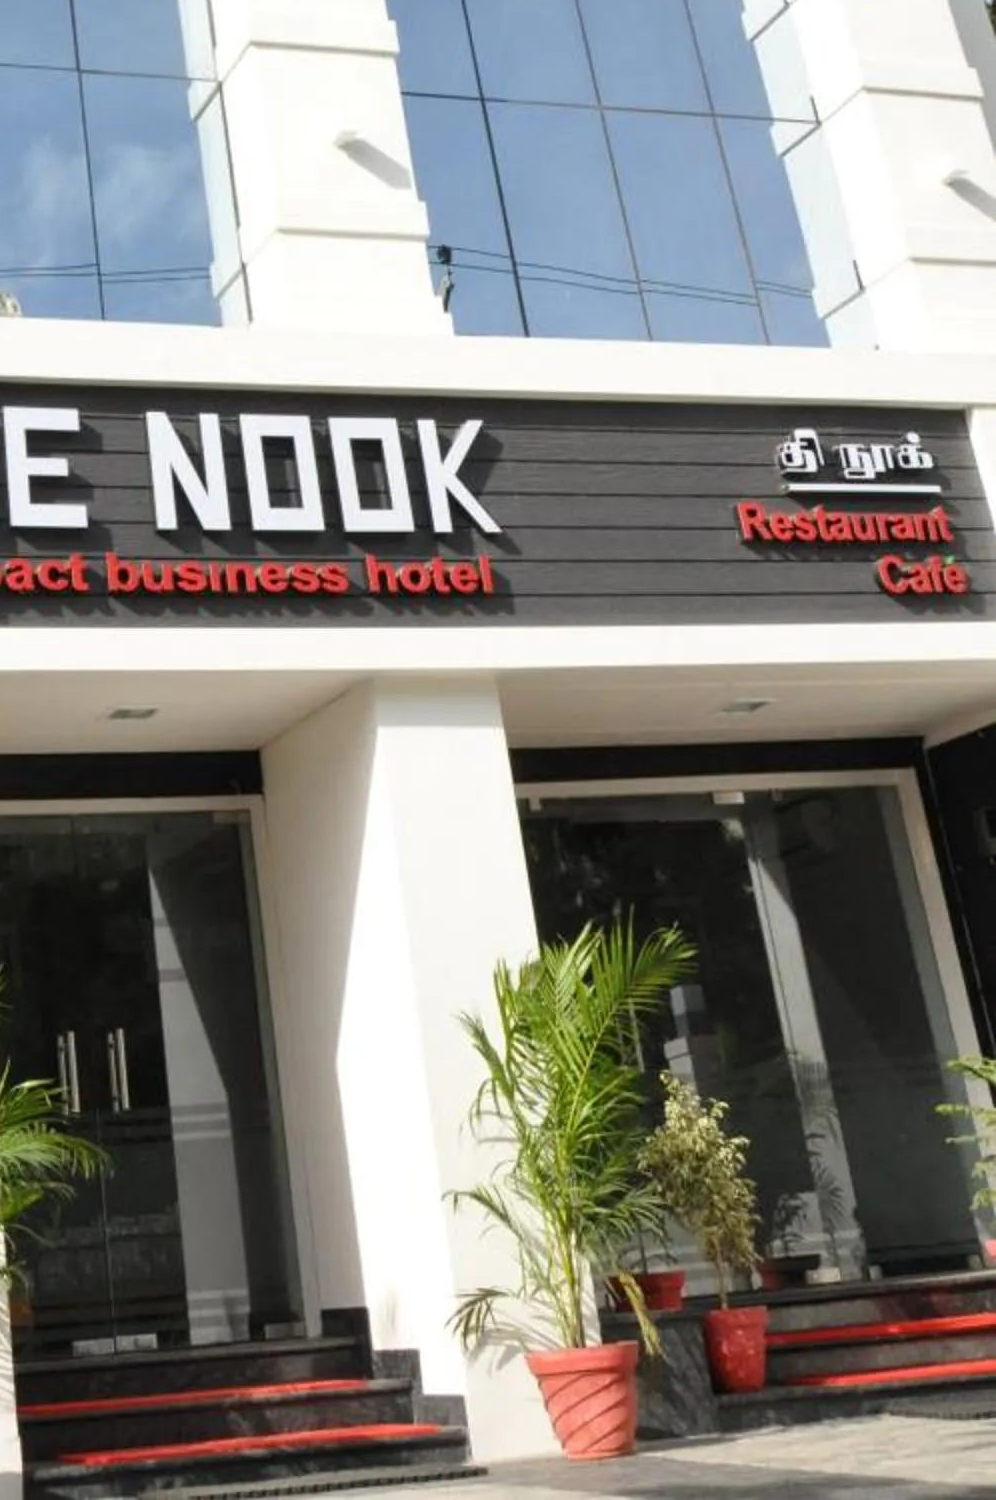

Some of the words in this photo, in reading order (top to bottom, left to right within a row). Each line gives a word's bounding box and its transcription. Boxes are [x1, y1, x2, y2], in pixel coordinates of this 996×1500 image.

[145, 410, 502, 534] NOOK
[736, 500, 955, 542] Restaurant
[105, 551, 350, 594] business
[365, 553, 495, 595] hotel
